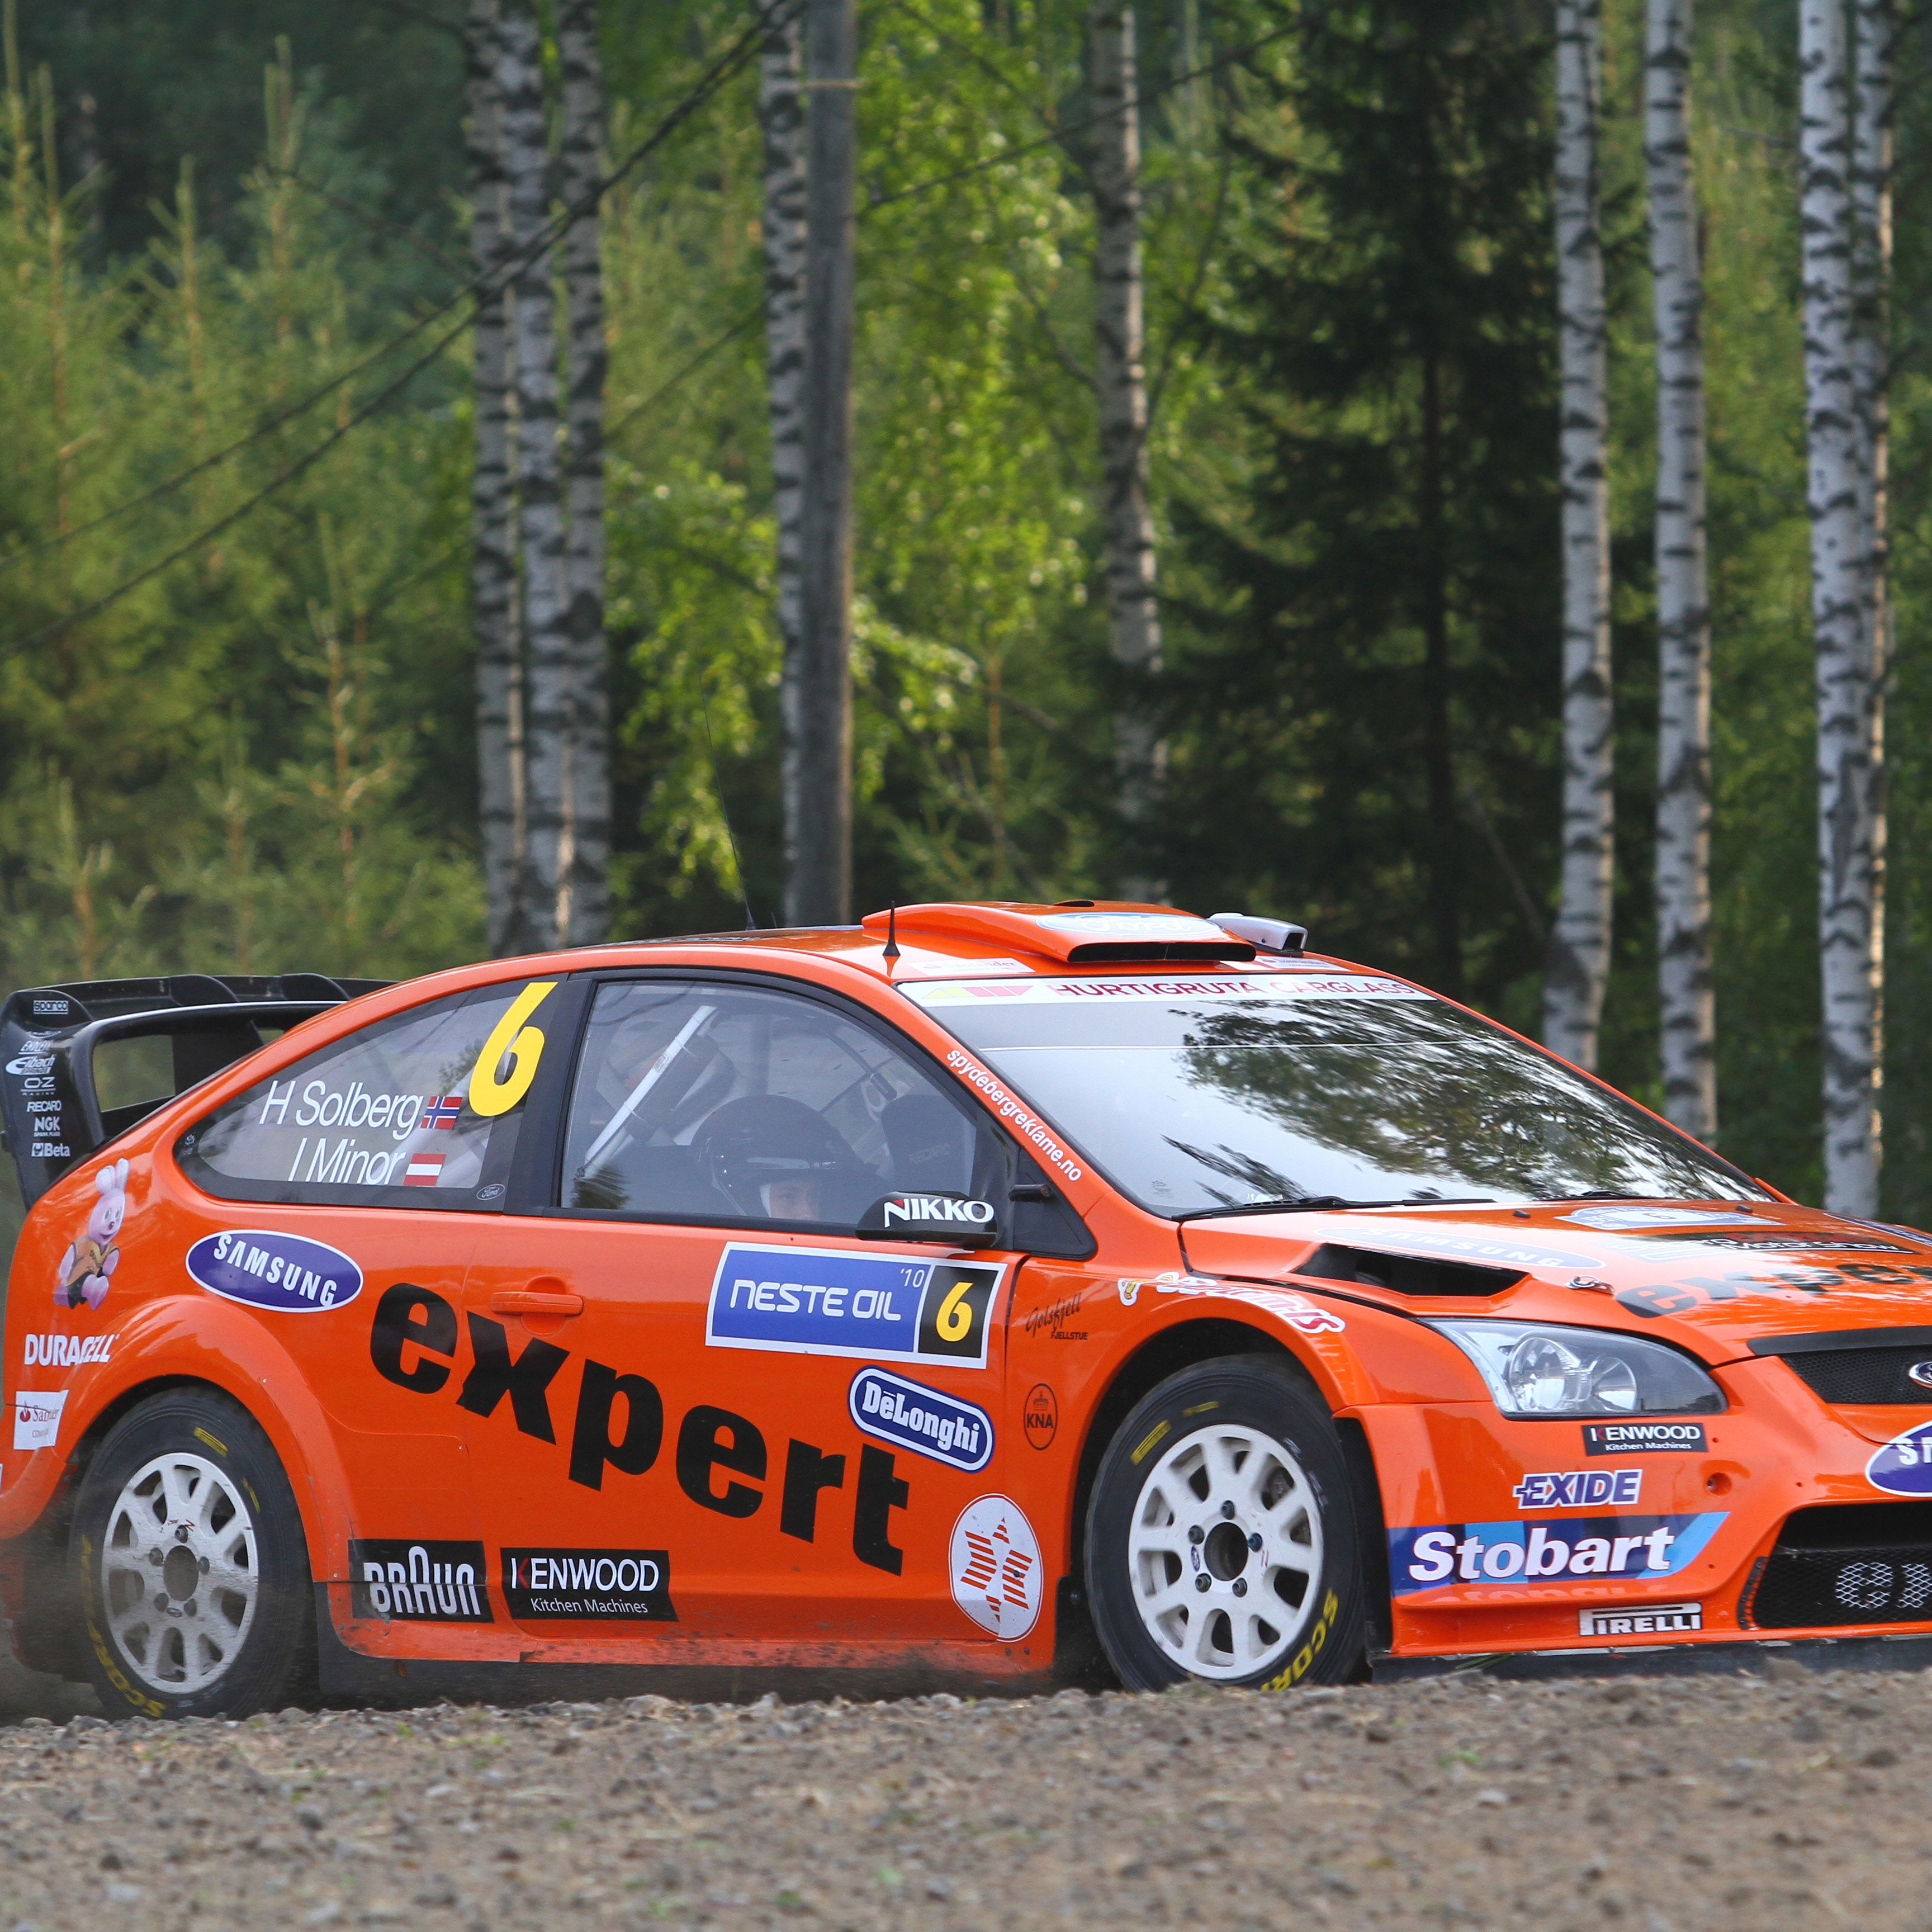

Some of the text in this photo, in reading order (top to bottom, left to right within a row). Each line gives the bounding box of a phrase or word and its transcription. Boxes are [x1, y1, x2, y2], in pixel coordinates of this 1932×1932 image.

[1044, 981, 1417, 996] HURTIGRUTA CARGLASS
[6, 1054, 56, 1075] Eibach
[468, 982, 558, 1117] 6
[26, 1100, 61, 1112] RECARO
[259, 1080, 424, 1141] H Solberg
[946, 1049, 1082, 1182] spydebergreklame.no
[34, 1116, 61, 1131] NGK
[44, 1143, 70, 1157] Beta
[288, 1138, 407, 1186] I Minor
[884, 1198, 995, 1228] NIKKO
[1360, 1229, 1565, 1267] SAMSUNG
[213, 1234, 338, 1307] SAMSUNG
[730, 1279, 901, 1321] NESTE OIL
[935, 1281, 974, 1342] 6
[24, 1333, 115, 1367] DURACELL
[1051, 1331, 1088, 1340] FJELLSTUE
[370, 1282, 910, 1577] expert
[1026, 1413, 1054, 1429] KNA
[1590, 1425, 1701, 1442] KENWOOD
[1605, 1441, 1692, 1451] Kitchen Machines
[1513, 1469, 1642, 1509] EXIDE
[1409, 1526, 1675, 1583] Stobart
[363, 1545, 481, 1616] BRAUN
[511, 1557, 660, 1592] KENWOOD
[530, 1598, 648, 1614] Kitchen Machines
[1579, 1602, 1702, 1636] PIRELLI
